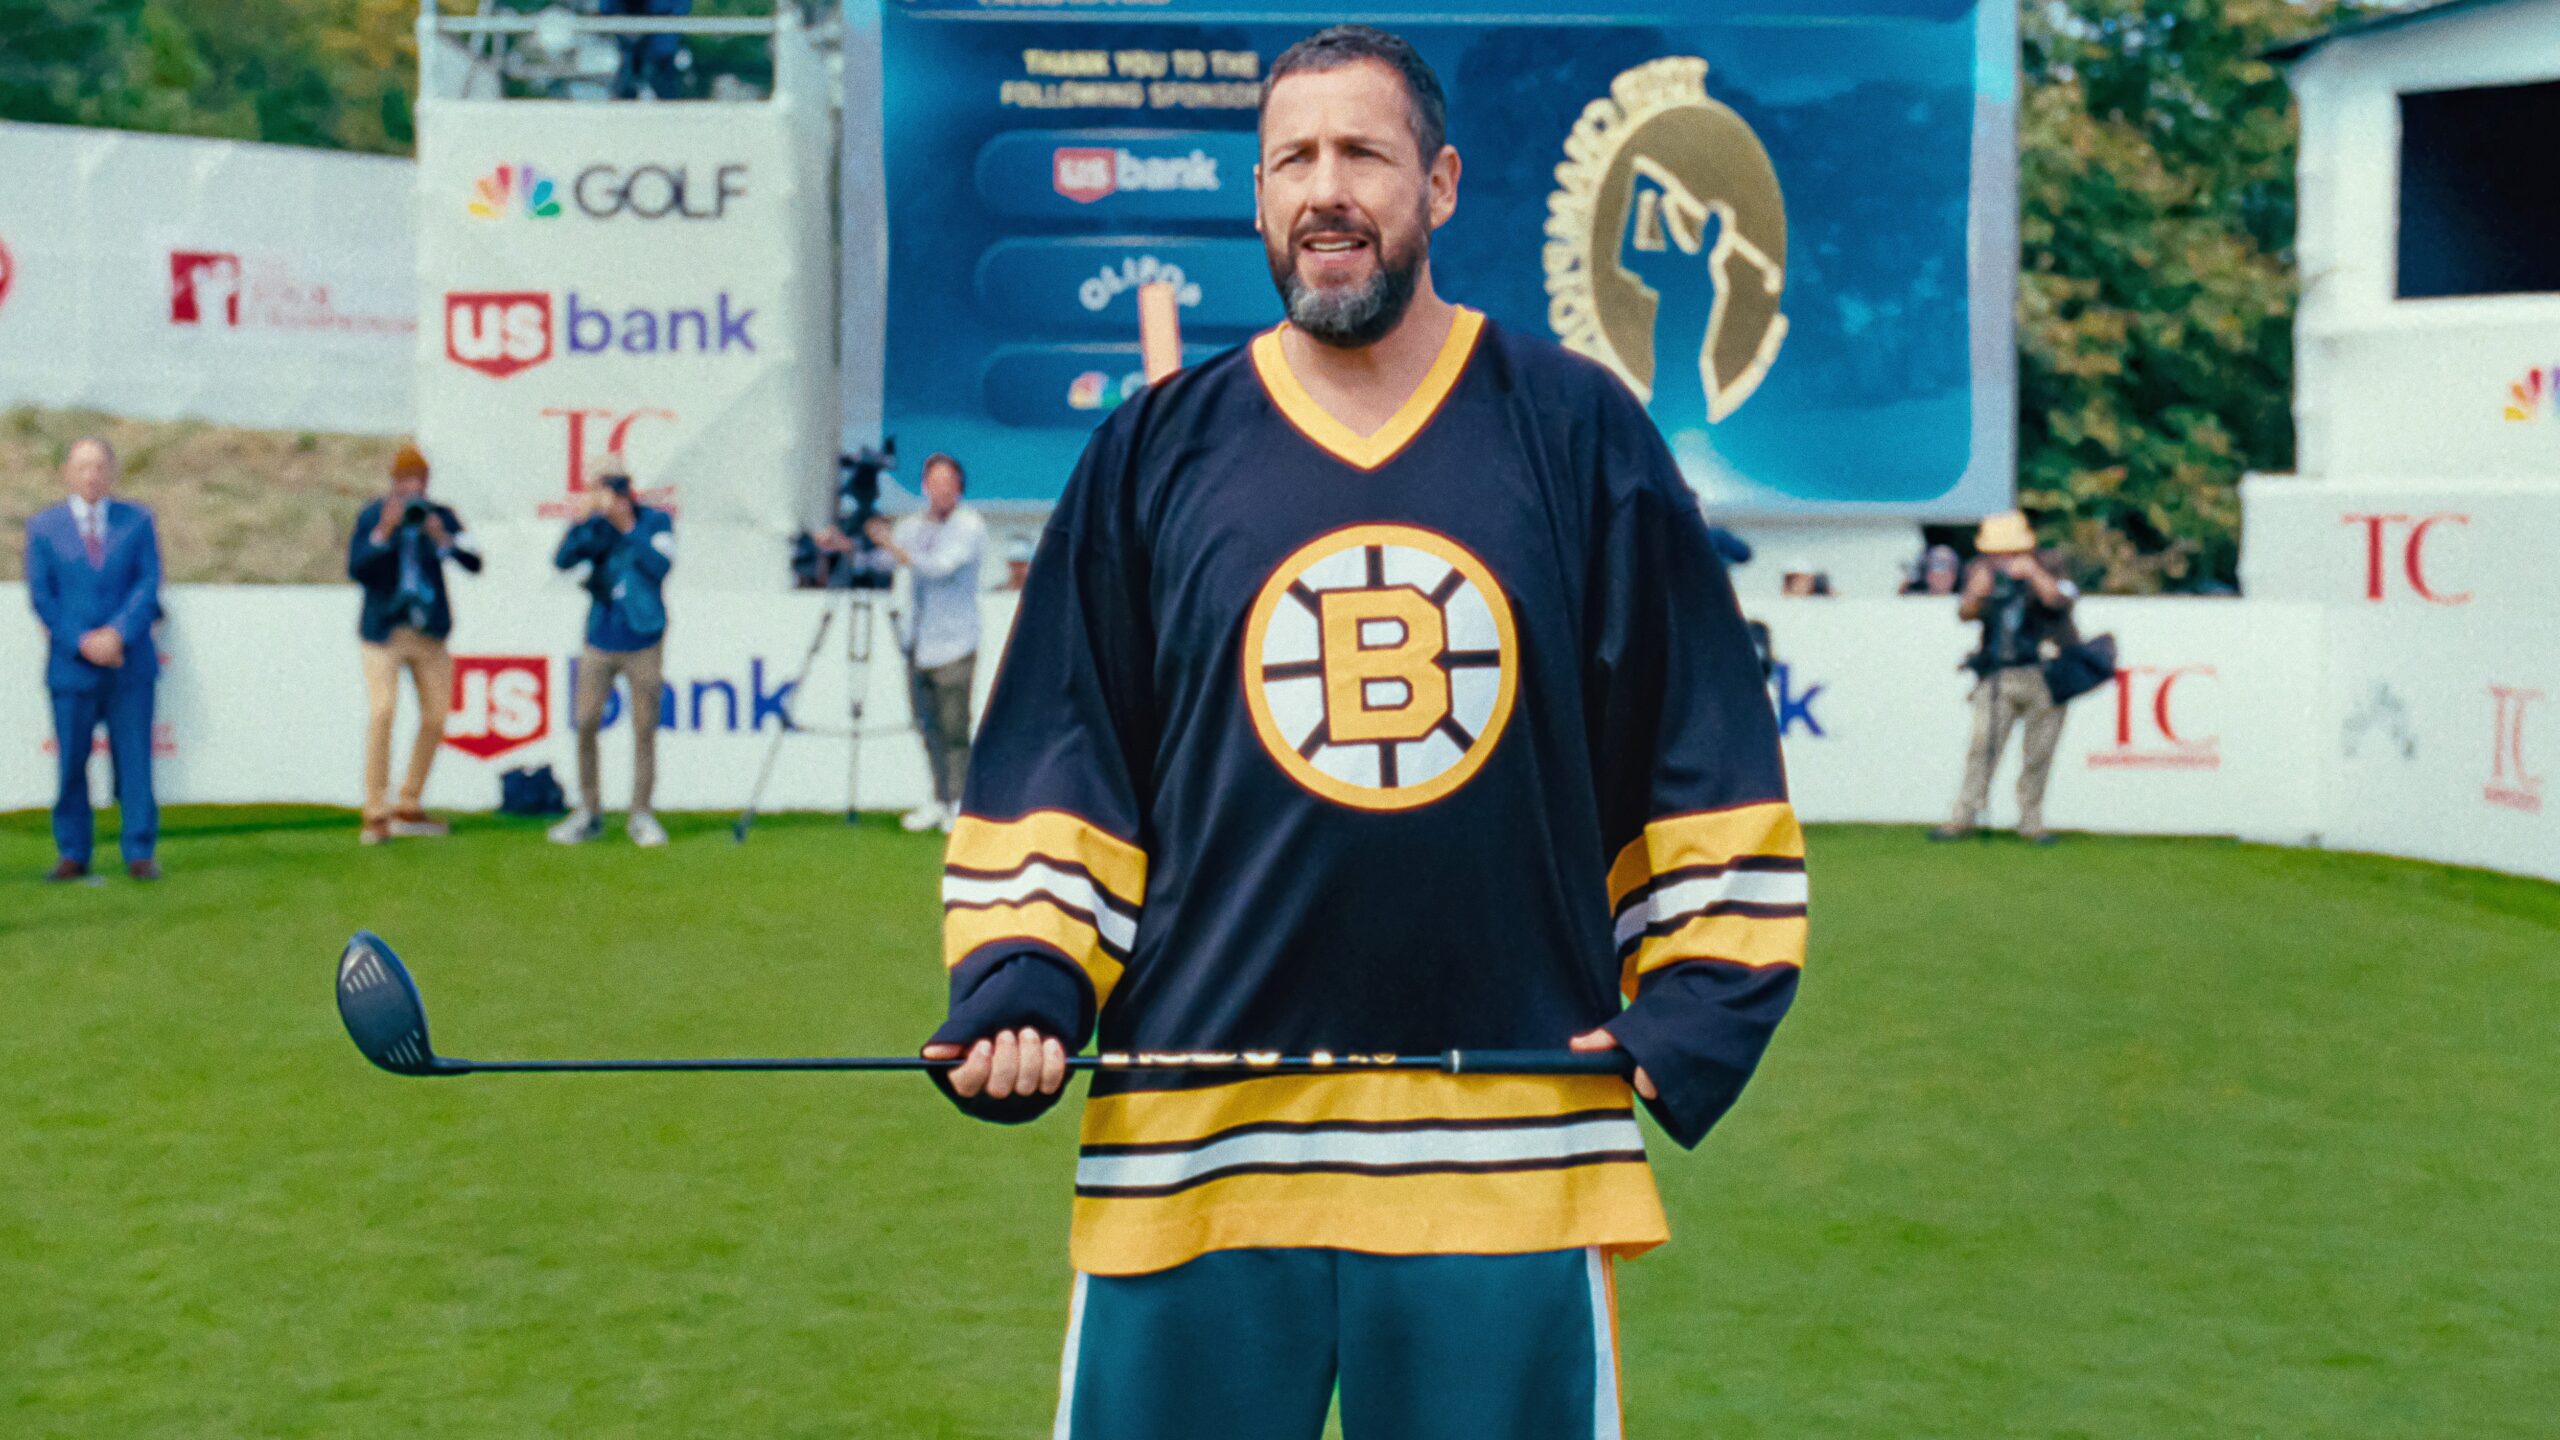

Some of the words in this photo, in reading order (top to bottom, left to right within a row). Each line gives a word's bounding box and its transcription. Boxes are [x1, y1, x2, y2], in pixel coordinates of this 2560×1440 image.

[1023, 49, 1110, 76] THANK
[1115, 50, 1168, 78] YOU
[1173, 49, 1207, 78] TO
[1212, 50, 1259, 78] THE
[1001, 81, 1144, 108] FOLLOWING
[574, 164, 749, 219] GOLF
[1117, 149, 1220, 191] bank
[566, 292, 757, 353] bank
[2342, 512, 2475, 606] TC
[1316, 582, 1454, 747] B
